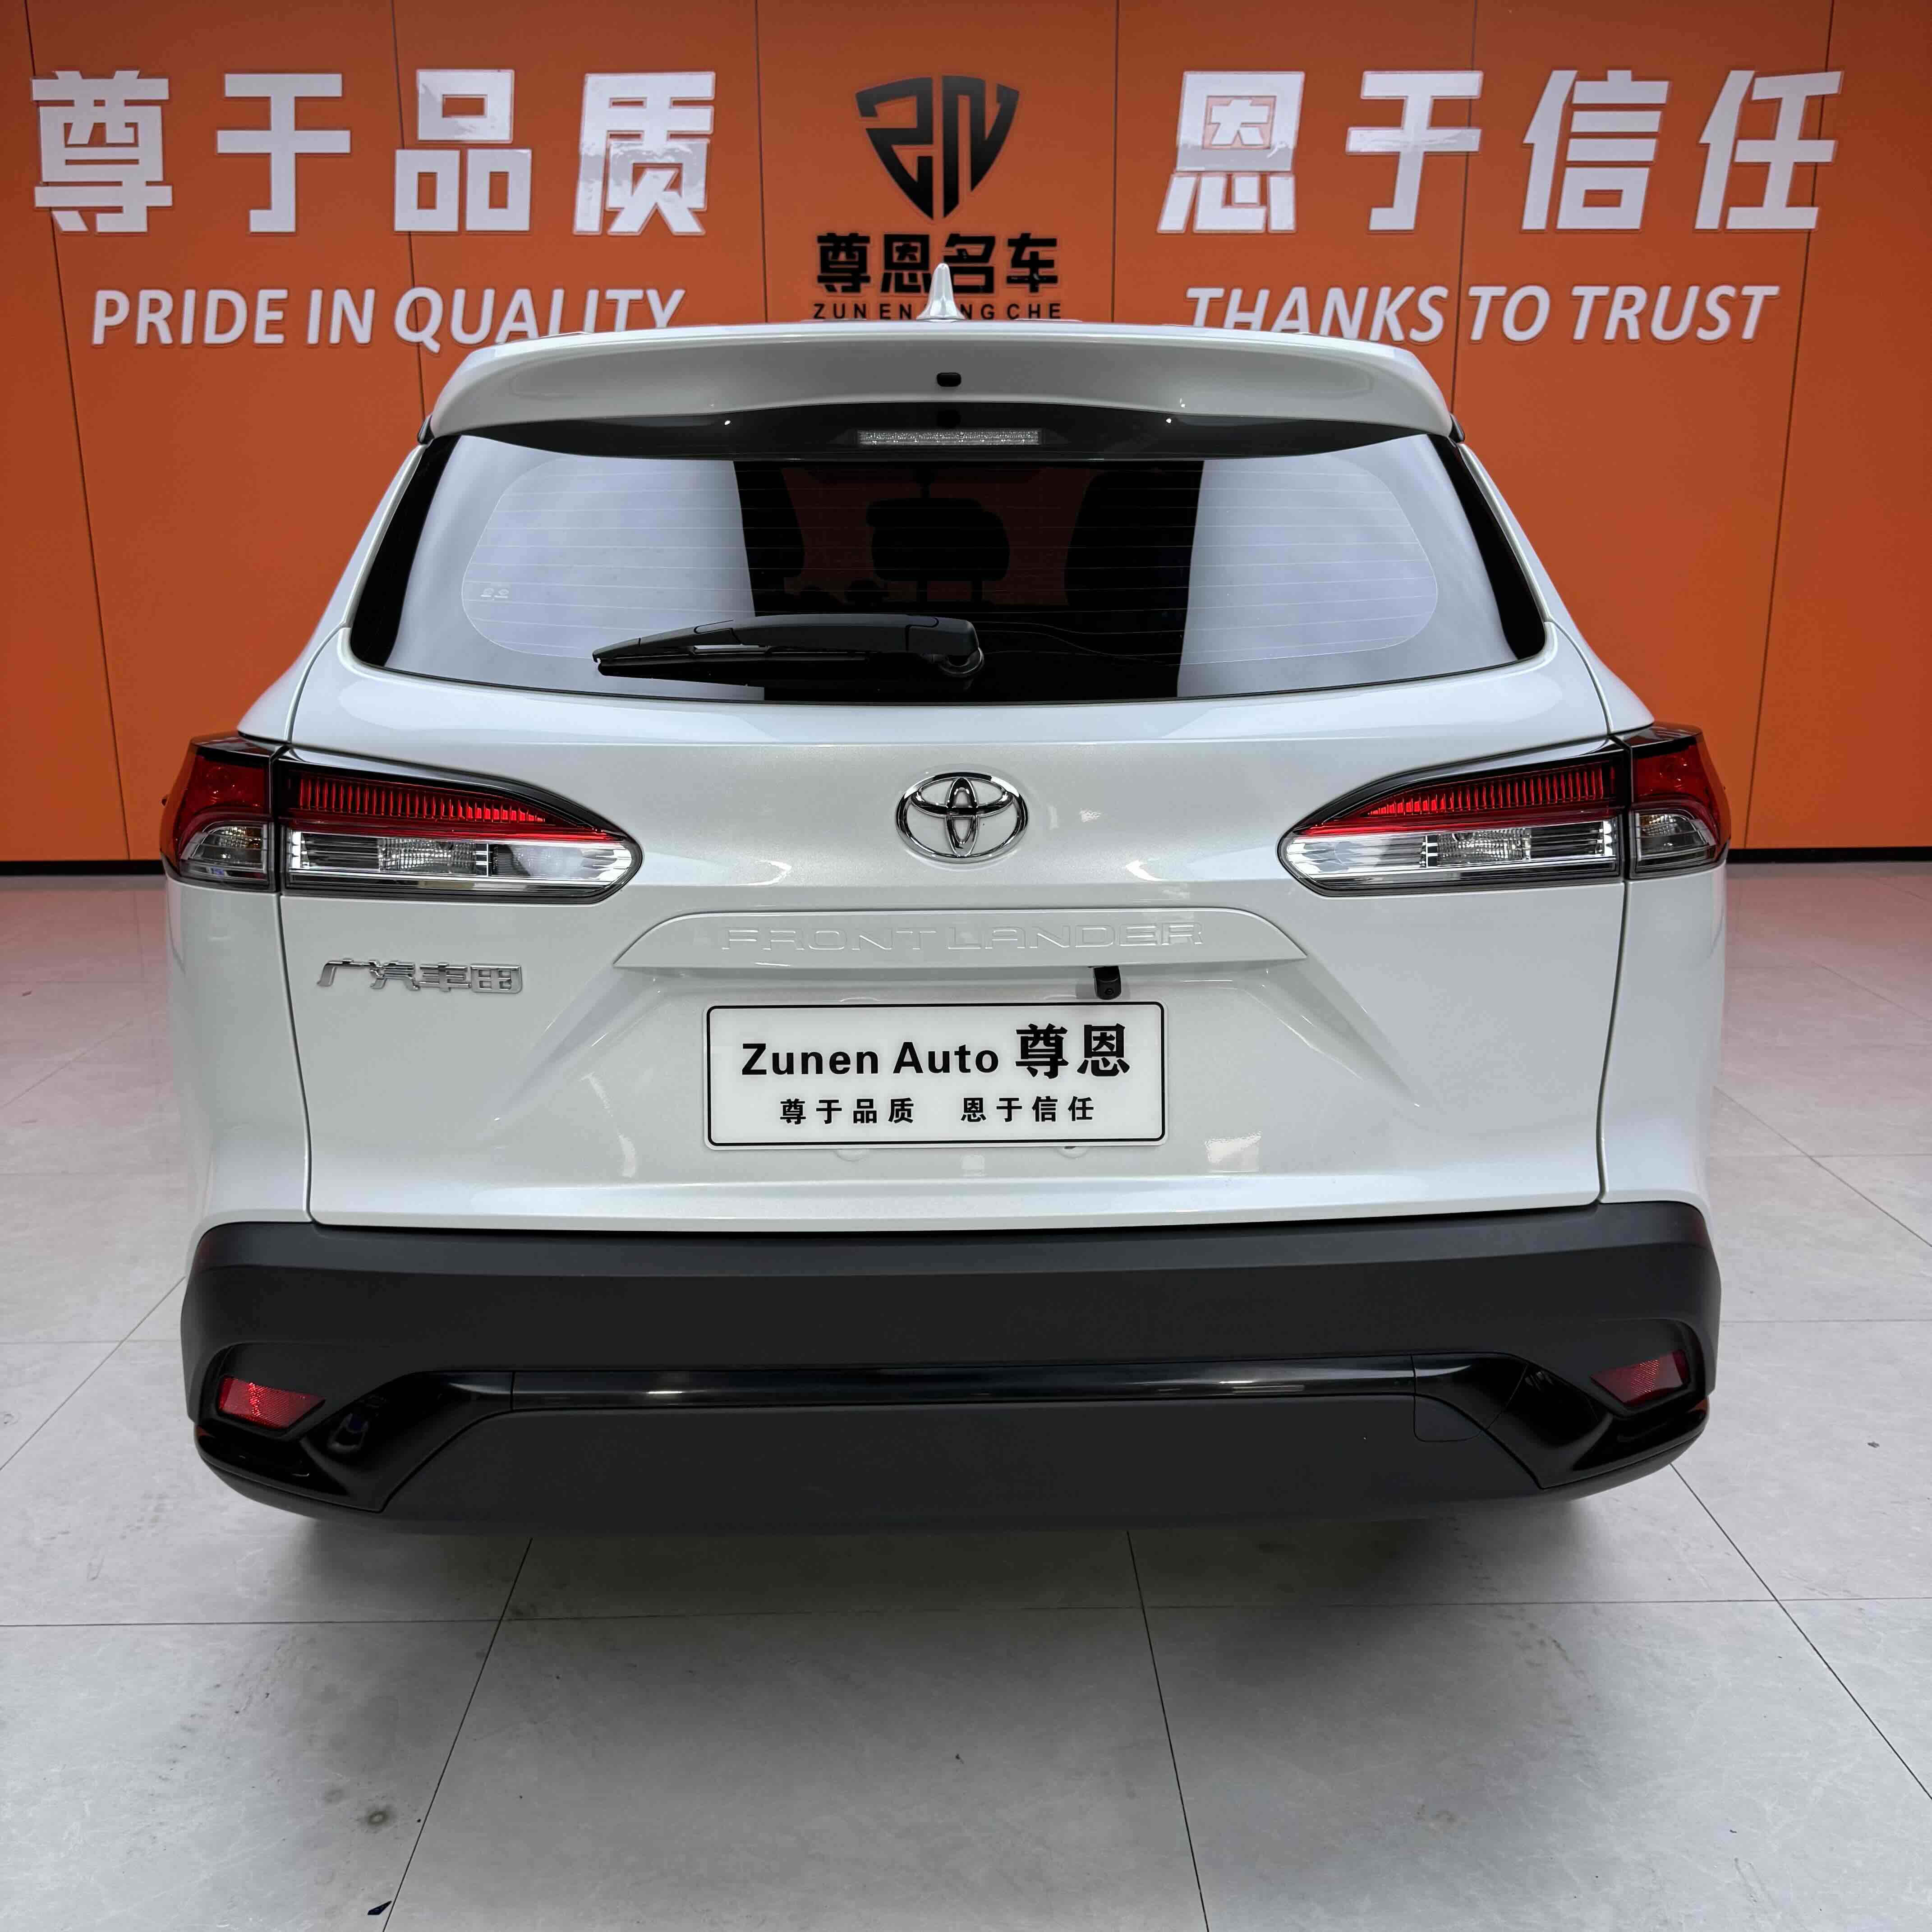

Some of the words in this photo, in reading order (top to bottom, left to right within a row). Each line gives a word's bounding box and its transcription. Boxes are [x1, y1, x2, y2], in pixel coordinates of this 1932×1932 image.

[32, 69, 715, 235] 尊于品质
[1157, 69, 1844, 233] 恩于信任
[817, 233, 1058, 293] 尊恩名车
[92, 289, 288, 344] PRIDE
[307, 289, 375, 344] IN
[1186, 286, 1449, 343] THANKS
[1468, 285, 1550, 343] TO
[1571, 285, 1780, 343] TRUST
[317, 957, 523, 994] 广汽丰田
[741, 1043, 879, 1076] Zunen
[893, 1041, 999, 1075] Auto
[1015, 1022, 1131, 1079] 尊恩
[780, 1098, 915, 1124] 尊于品质
[961, 1096, 1095, 1123] 恩于信任
